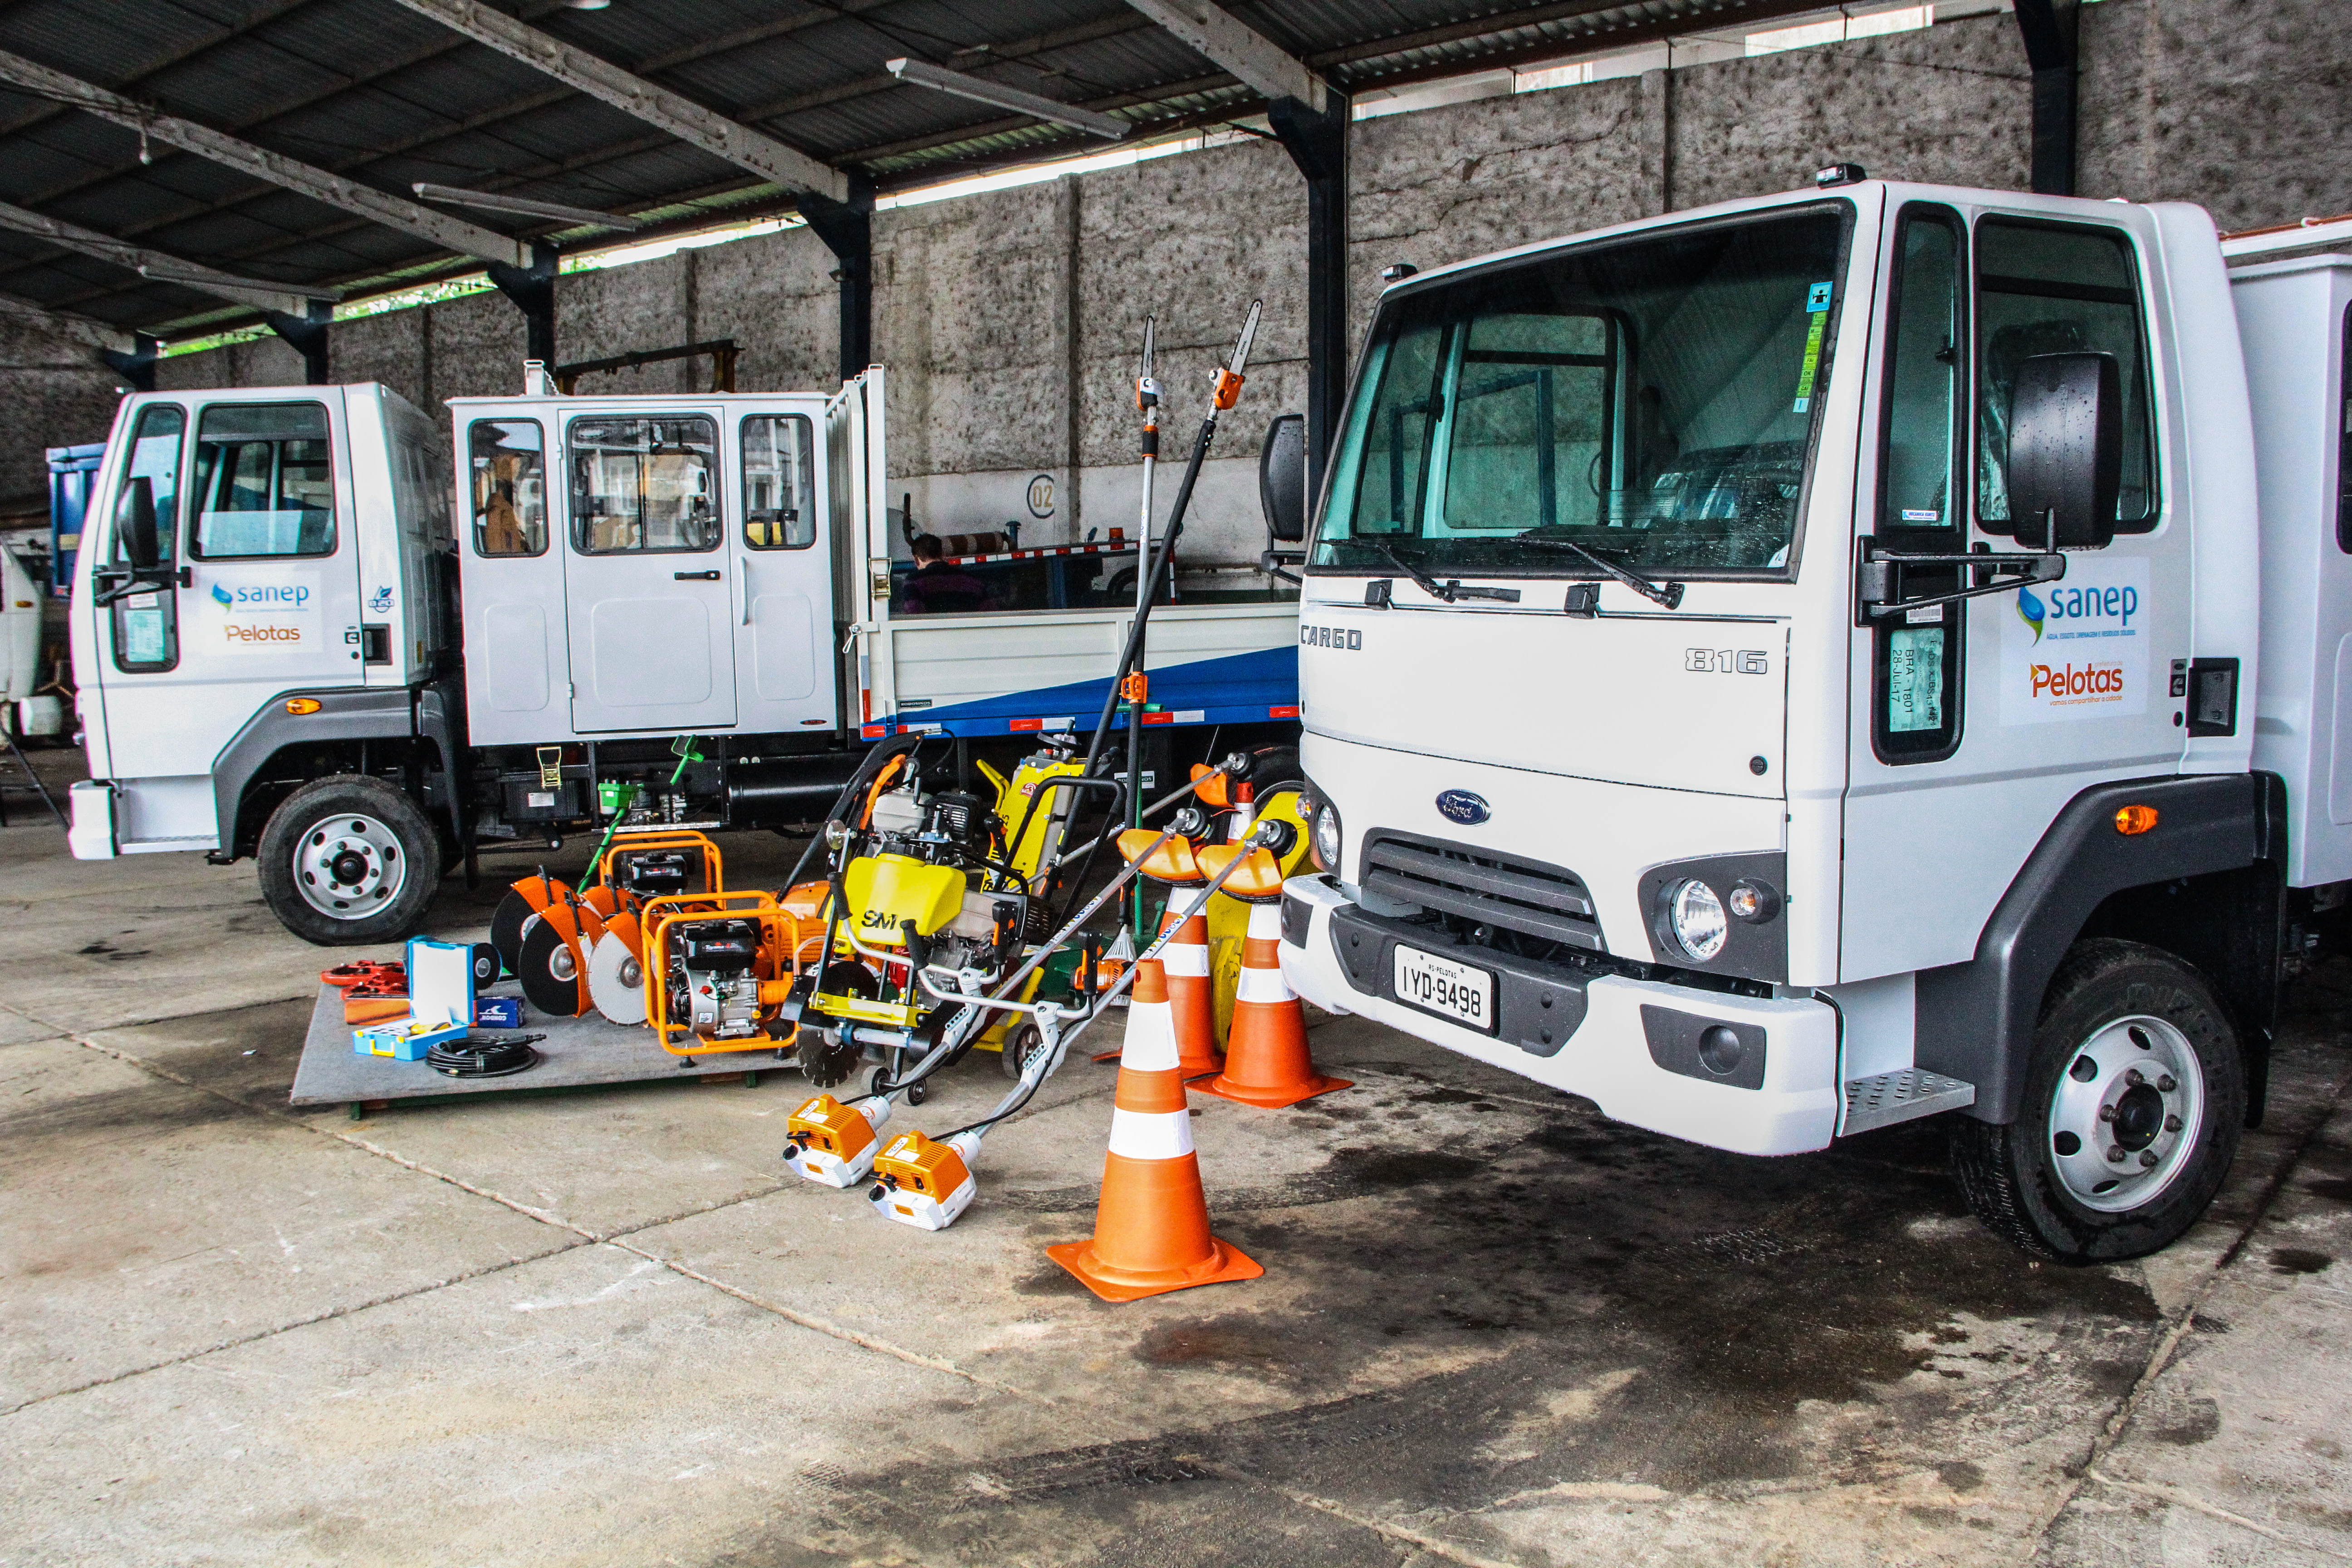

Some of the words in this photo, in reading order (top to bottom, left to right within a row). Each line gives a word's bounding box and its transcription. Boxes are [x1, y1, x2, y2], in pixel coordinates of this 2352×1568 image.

[1033, 485, 1052, 507] 02
[237, 585, 309, 607] sanep
[2050, 586, 2137, 626] sanep
[225, 624, 300, 641] Pelotas
[1301, 625, 1362, 650] CARGO
[1686, 648, 1767, 674] 816
[1906, 649, 1914, 675] BRA
[1891, 650, 1902, 702] 28-Jul-17
[2030, 663, 2123, 697] Pelotas
[1903, 688, 1914, 713] 1801
[1443, 795, 1473, 818] Ford
[1429, 964, 1457, 979] RS-PELOTAS
